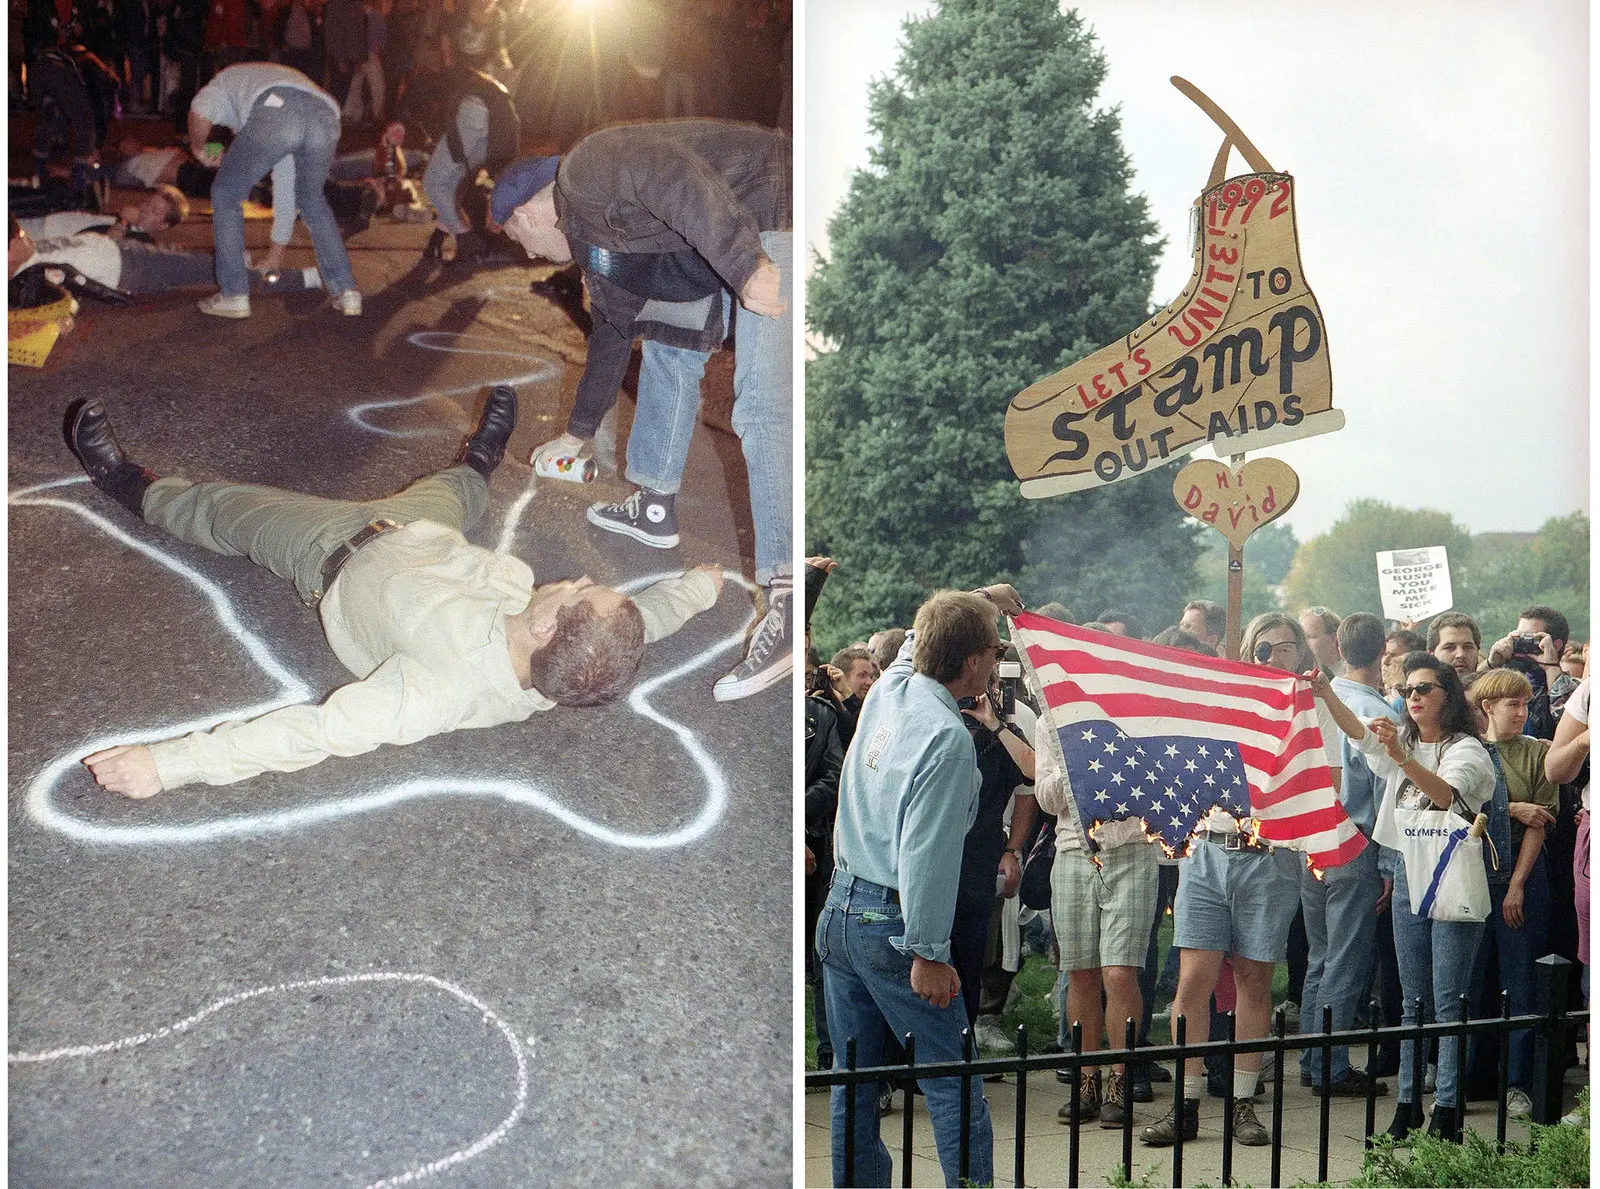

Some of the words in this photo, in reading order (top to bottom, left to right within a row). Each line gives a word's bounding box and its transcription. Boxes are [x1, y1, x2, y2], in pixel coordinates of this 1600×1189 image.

[1207, 178, 1290, 227] 1992
[1246, 266, 1292, 300] TO
[1076, 348, 1152, 410] LET'S
[1167, 227, 1239, 347] UNITE!
[1094, 426, 1175, 482] OUT
[1207, 394, 1305, 442] AIDS
[1183, 485, 1277, 530] David
[1382, 563, 1443, 575] GEORGE
[1393, 572, 1433, 581] BUSH
[1392, 584, 1437, 595] MAKE
[1398, 579, 1430, 589] YOU
[1405, 594, 1428, 602] ME
[1400, 600, 1432, 609] SICK
